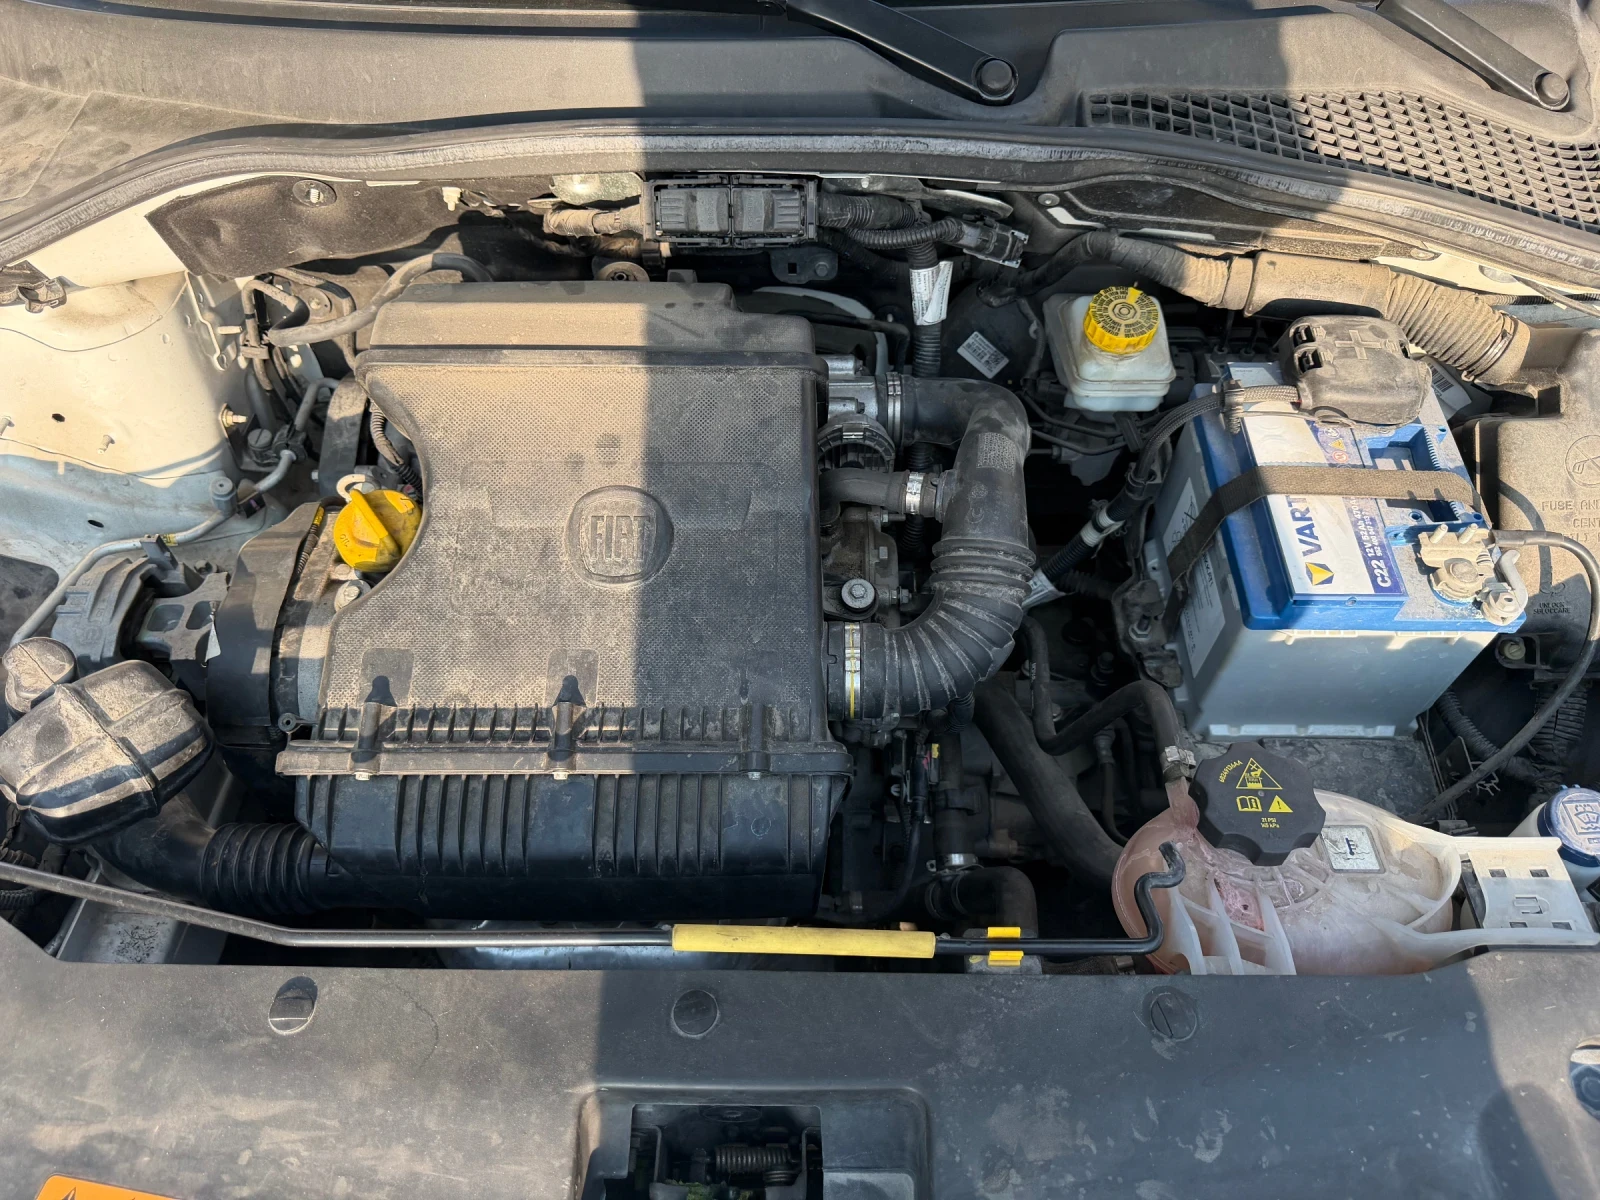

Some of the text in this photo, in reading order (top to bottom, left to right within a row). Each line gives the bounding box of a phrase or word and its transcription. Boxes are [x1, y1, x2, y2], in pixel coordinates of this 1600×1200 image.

[1541, 500, 1574, 511] FUSE
[589, 515, 651, 560] FIAT
[1285, 495, 1322, 557] VART
[1365, 541, 1375, 557] 12V
[1371, 559, 1392, 588] C22
